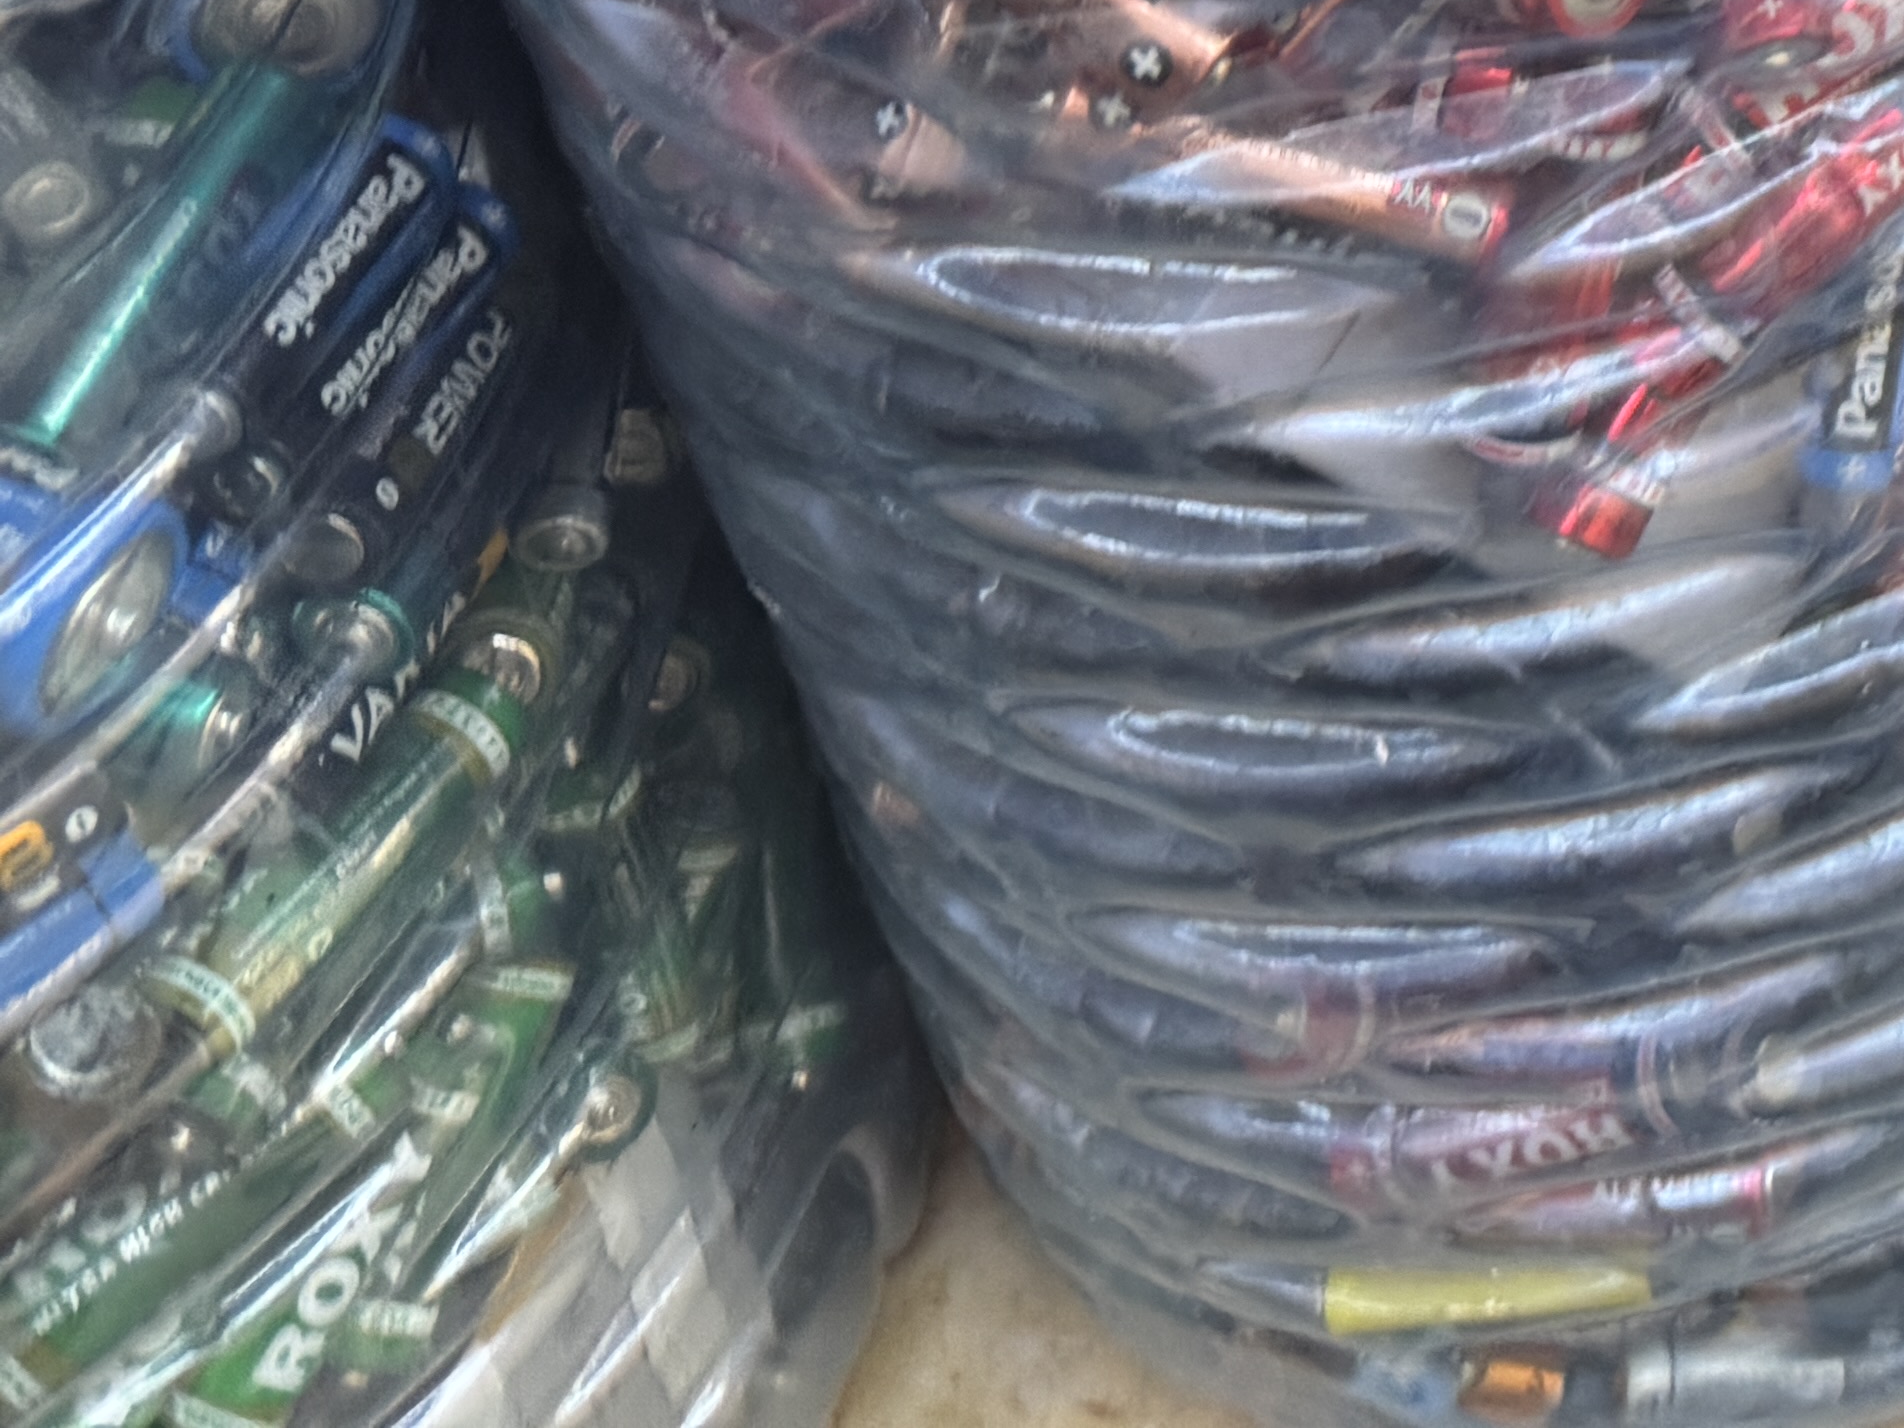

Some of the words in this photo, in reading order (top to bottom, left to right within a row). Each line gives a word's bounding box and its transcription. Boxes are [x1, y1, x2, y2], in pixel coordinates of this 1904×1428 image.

[263, 154, 424, 348] Panasonic
[321, 229, 488, 418] Panasonic
[419, 311, 511, 456] POWER
